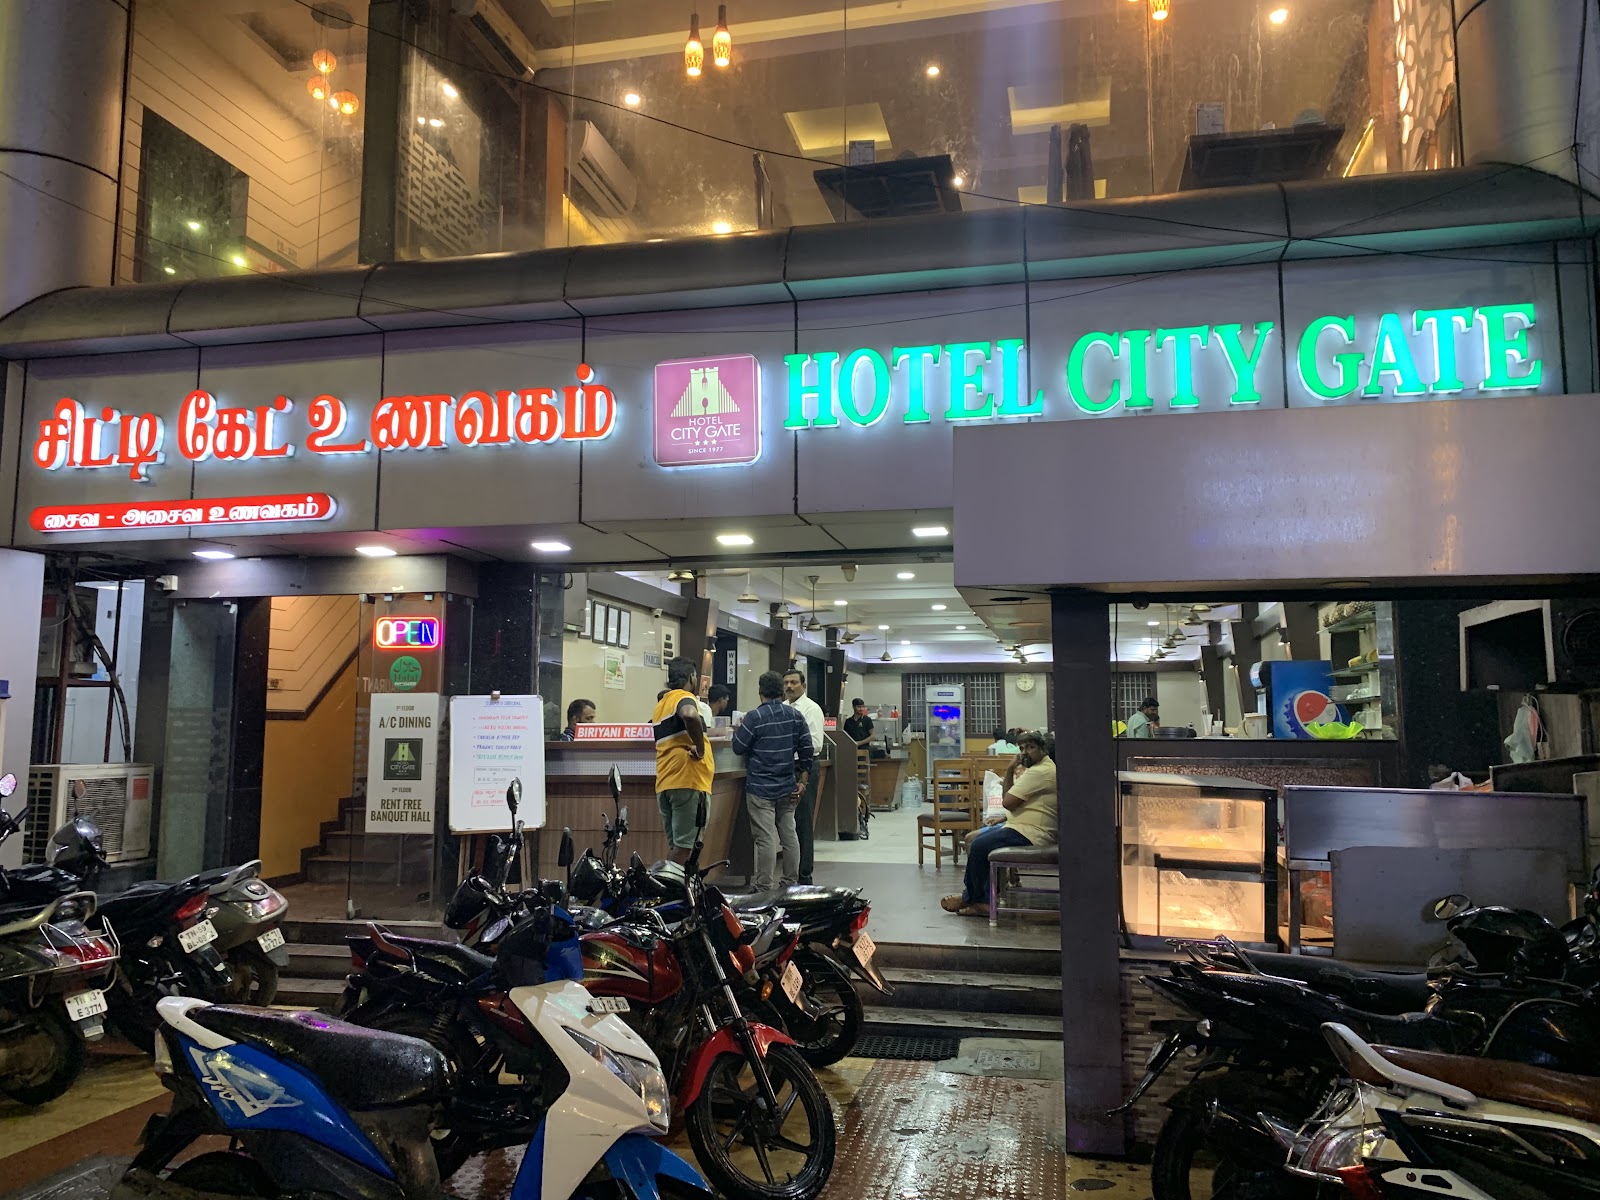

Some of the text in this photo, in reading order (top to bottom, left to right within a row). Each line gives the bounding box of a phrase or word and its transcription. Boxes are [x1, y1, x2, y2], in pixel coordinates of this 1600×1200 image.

[783, 303, 1543, 430] HOTEL CITY GATE
[33, 363, 617, 482] சிட்டி கேட் உணவகம்
[689, 416, 722, 426] HOTEL
[670, 424, 741, 440] CITY GATE
[43, 512, 100, 529] சைவ
[121, 505, 202, 526] அசைவ
[208, 495, 319, 521] உணவகம்
[378, 619, 437, 646] OPEN
[378, 716, 432, 729] A/C DINING
[577, 726, 622, 738] BIRIYANI
[380, 798, 423, 810] RENT FREE
[370, 810, 431, 823] BANQUET HALL
[76, 1002, 103, 1018] E 3771
